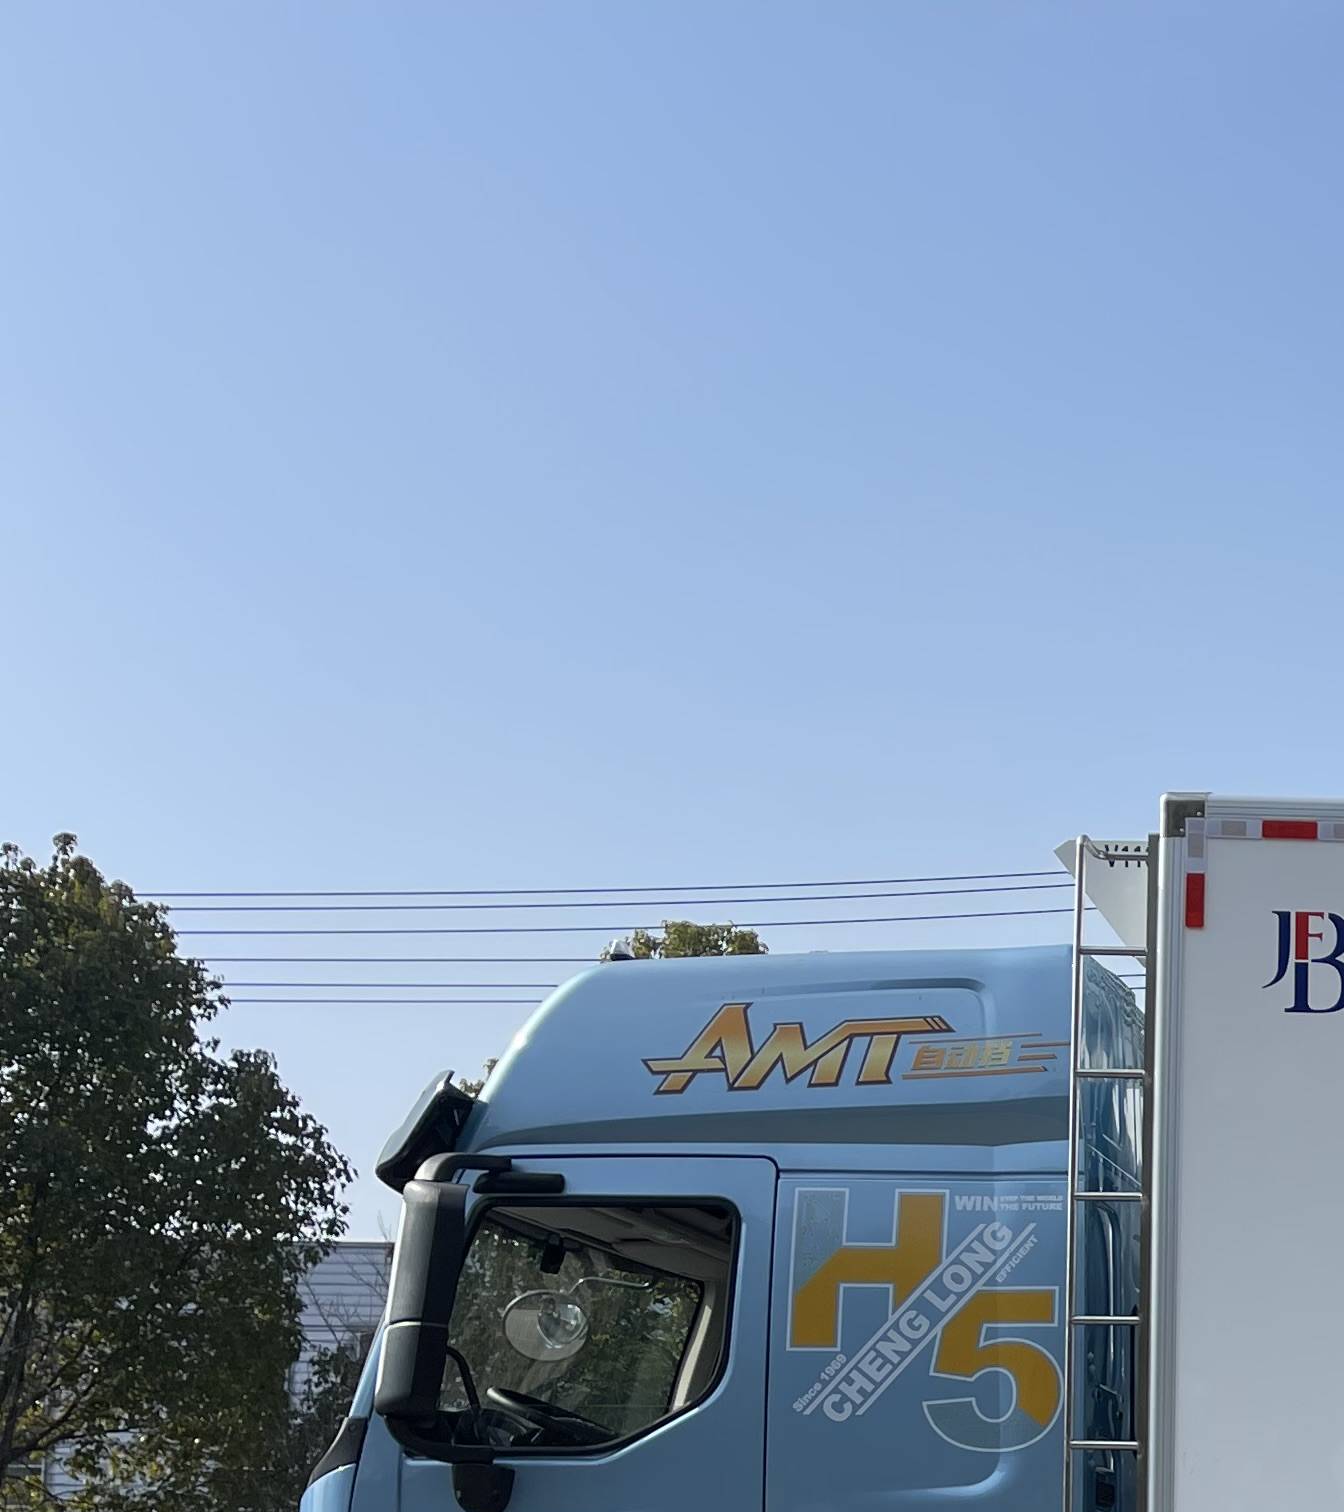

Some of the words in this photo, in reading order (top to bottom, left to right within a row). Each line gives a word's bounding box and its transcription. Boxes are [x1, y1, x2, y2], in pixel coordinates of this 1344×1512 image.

[641, 1002, 956, 1096] AMT
[955, 1195, 997, 1211] WIN
[823, 1310, 930, 1422] CHENG
[923, 1222, 1013, 1312] LONG
